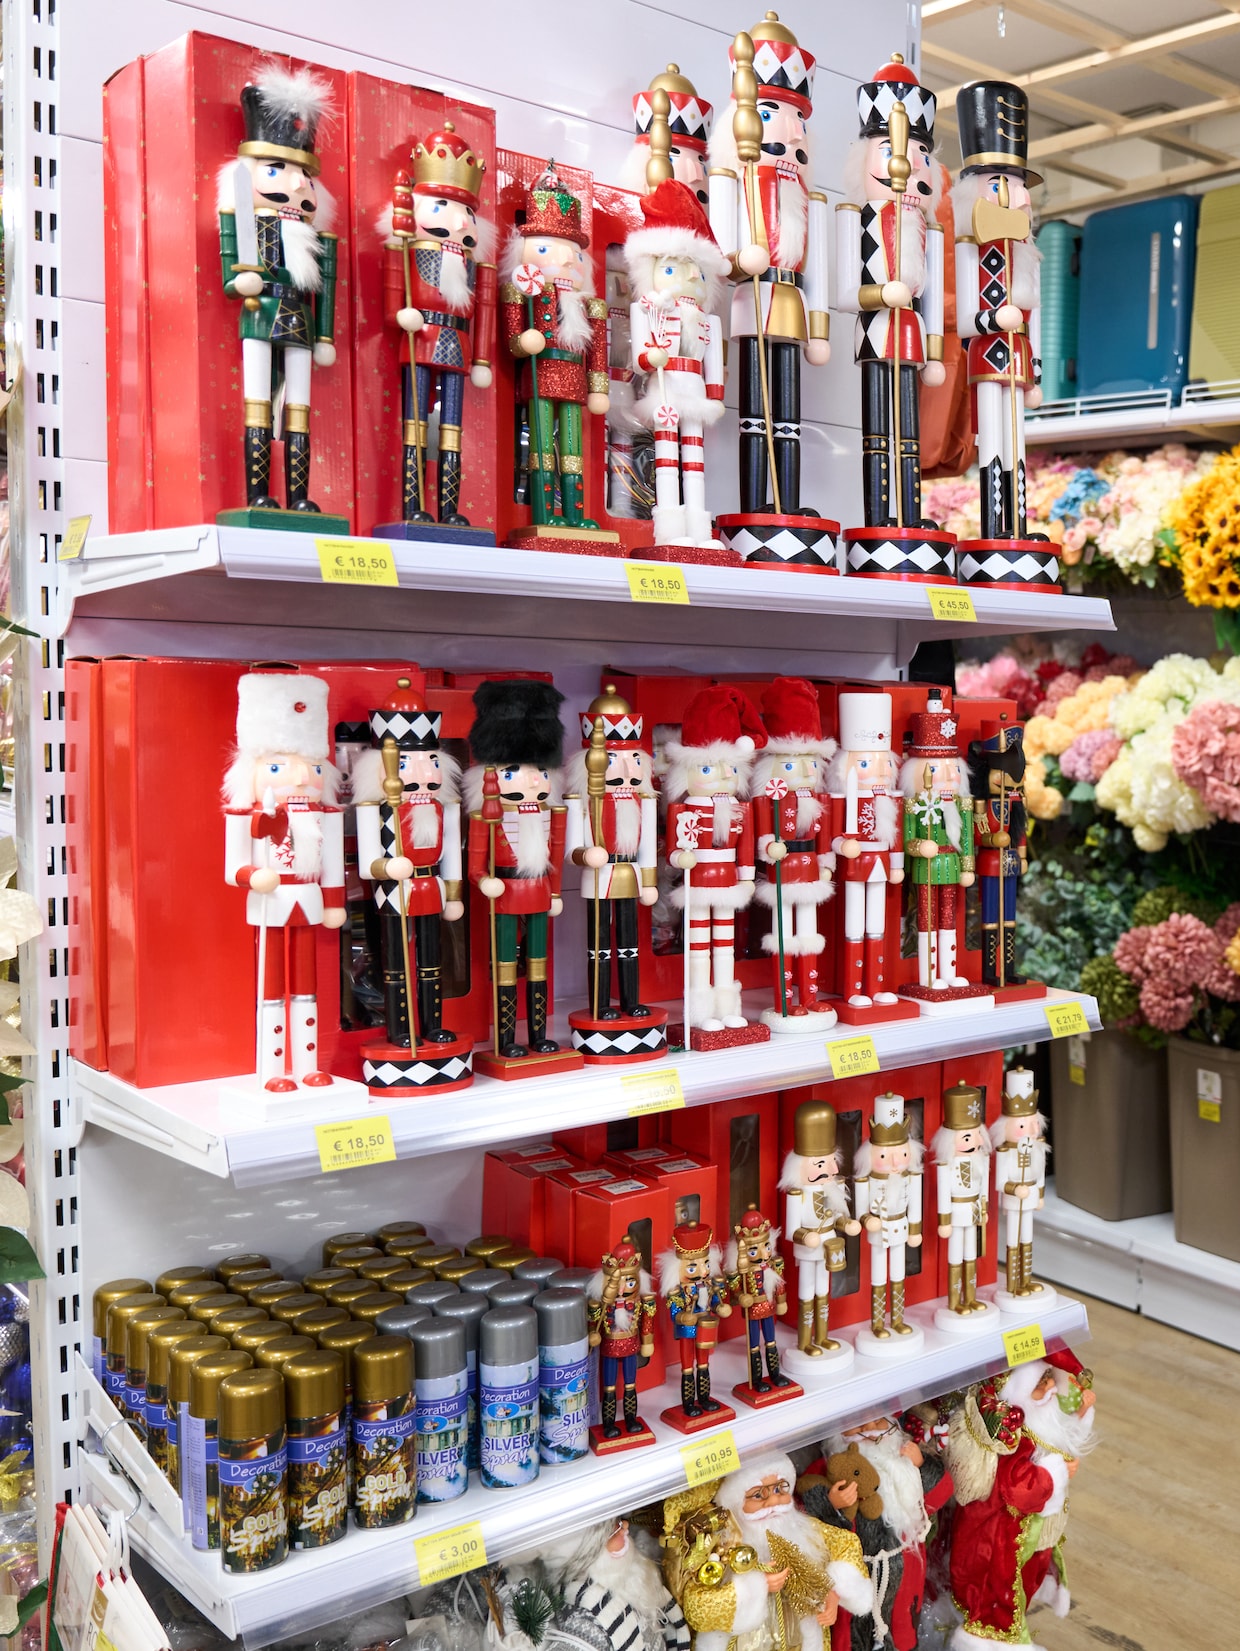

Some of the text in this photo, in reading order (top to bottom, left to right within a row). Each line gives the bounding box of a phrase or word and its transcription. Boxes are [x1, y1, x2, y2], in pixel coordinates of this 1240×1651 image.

[335, 556, 387, 569] € 18,50
[640, 578, 681, 590] € 18,50
[939, 600, 969, 611] € 45,50
[1056, 1013, 1082, 1025] € 21,79
[840, 1049, 872, 1063] € 18,50
[334, 1134, 385, 1152] € 18,50
[1013, 1337, 1040, 1352] € 14,59
[416, 1401, 459, 1415] coration
[563, 1408, 590, 1427] SILV
[356, 1419, 413, 1437] Decoration
[484, 1433, 530, 1451] SILVER
[417, 1447, 459, 1466] ILVER
[480, 1448, 528, 1472] Spray
[695, 1457, 703, 1468] €
[705, 1446, 732, 1464] 10,95
[365, 1469, 407, 1491] GOLD
[416, 1461, 458, 1488] pray
[317, 1483, 347, 1506] GOL
[355, 1481, 411, 1511] Spray
[243, 1506, 286, 1532] GOLD
[440, 1540, 478, 1560] € 3,00
